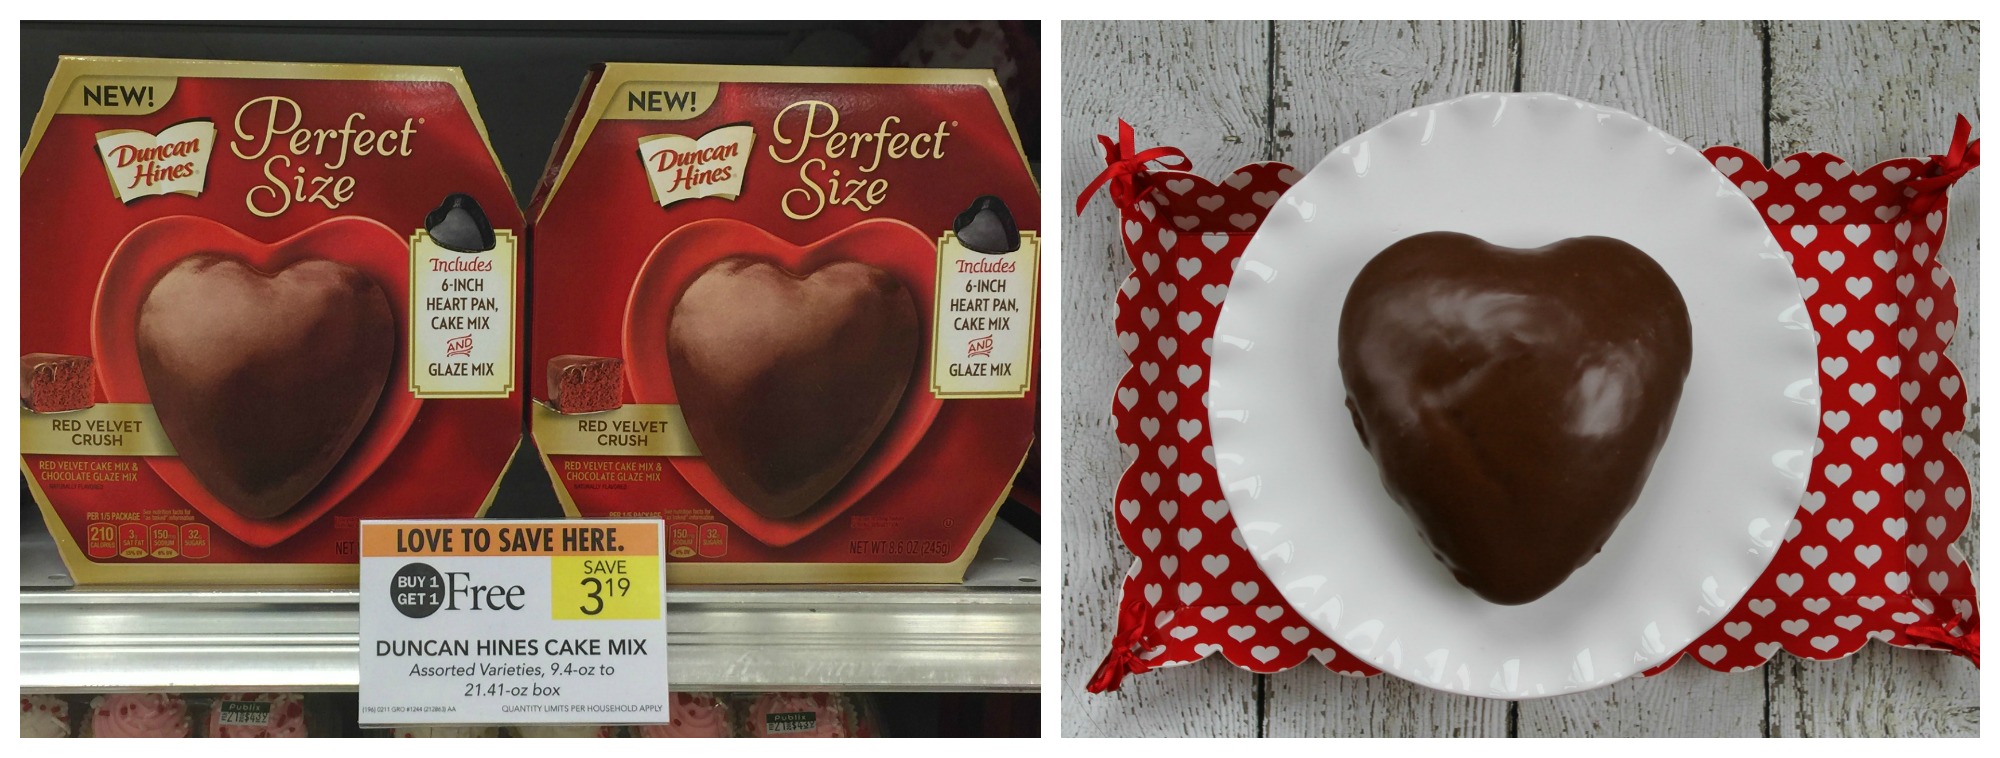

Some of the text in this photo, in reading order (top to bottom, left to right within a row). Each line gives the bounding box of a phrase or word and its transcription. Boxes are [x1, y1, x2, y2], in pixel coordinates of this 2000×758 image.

[84, 85, 154, 108] NEW!
[628, 90, 696, 112] NEW!
[230, 95, 418, 170] Perfect
[768, 99, 950, 173] Perfect
[108, 137, 200, 168] Duncan
[649, 142, 739, 172] Duncan
[127, 160, 195, 190] Hines
[667, 165, 732, 193] Hines
[246, 154, 356, 218] Size
[781, 158, 889, 220] Size
[429, 256, 493, 272] Includes
[955, 257, 1016, 273] Includes
[441, 278, 484, 292] 6-INCH
[965, 279, 1007, 293] 6-INCH
[426, 297, 499, 312] HEART PAN,
[950, 298, 1019, 313] HEART PAN,
[431, 316, 490, 330] CAKE MIX
[954, 317, 1010, 331] CAKE MIX
[446, 337, 474, 354] AND
[967, 337, 994, 354] AND
[428, 362, 495, 376] GLAZE MIX
[949, 363, 1012, 377] GLAZE MIX
[52, 419, 143, 433] RED VELVET
[578, 419, 668, 433] RED VELVET
[71, 433, 123, 446] CRUSH
[597, 434, 648, 447] CRUSH
[39, 460, 139, 472] RED VELVET CAKE MIX &
[564, 461, 663, 472] RED VELVET CAKE MIX &
[41, 471, 138, 482] CHOCOLATE GLAZE MIX
[566, 471, 661, 482] CHOCOLATE GLAZE MIX
[87, 511, 141, 521] PER 1/5 PACKAGE
[90, 526, 114, 541] 210
[397, 527, 625, 553] LOVE TO SAVE HERE.
[336, 541, 355, 555] NET
[850, 540, 951, 557] NET WT 8.6 OZ (245g)
[583, 560, 627, 575] SAVE
[398, 576, 439, 588] BUY 1
[444, 571, 525, 611] Free
[398, 593, 439, 605] GET 1
[376, 638, 648, 657] DUNCAN HINES CAKE MIX
[409, 662, 615, 678] Assorted Varieties, 9.4-oz to
[464, 682, 561, 697] 21.41-oz box
[229, 703, 261, 711] Publix
[501, 704, 663, 713] QUANTITY LIMITS PER HOUSEHOLD APPLY
